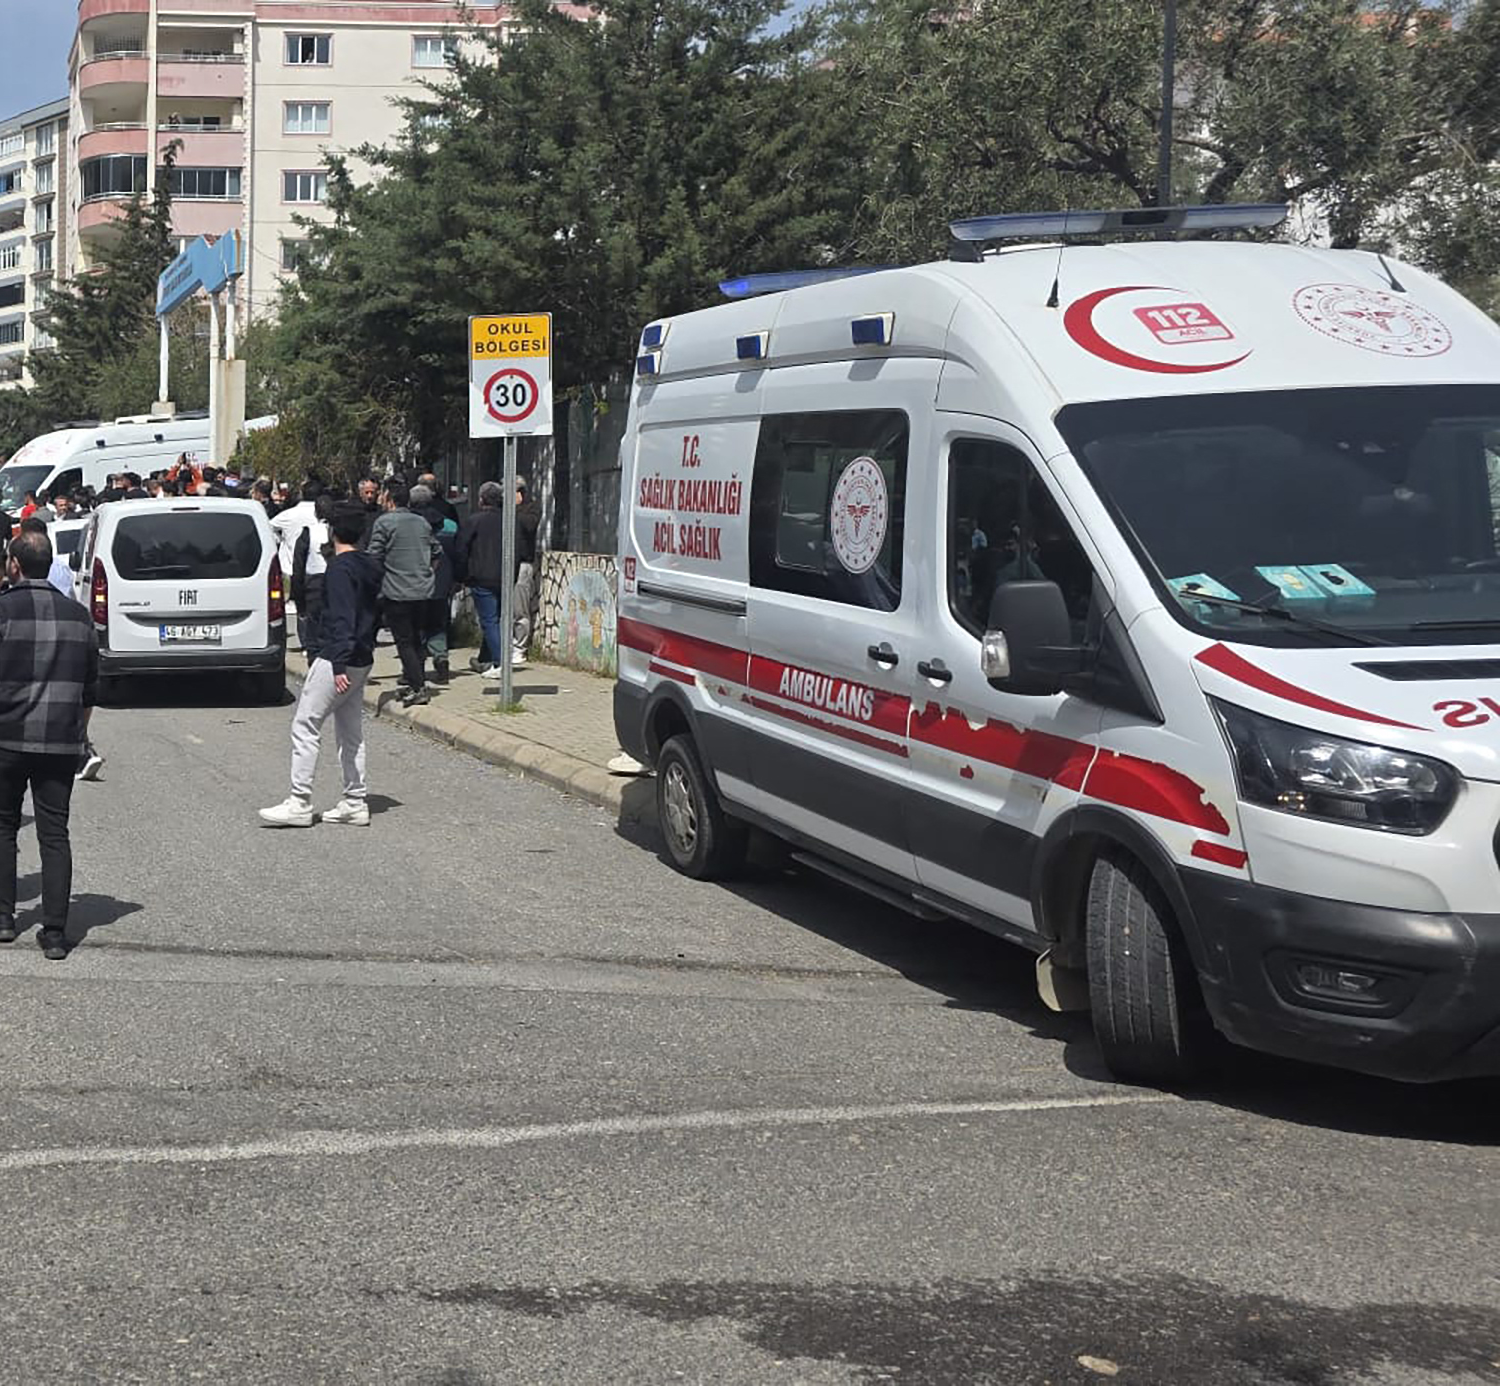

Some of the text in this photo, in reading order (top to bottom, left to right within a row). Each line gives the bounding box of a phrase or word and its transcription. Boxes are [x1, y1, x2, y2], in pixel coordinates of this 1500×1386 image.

[488, 323, 533, 335] OKUL
[1147, 308, 1211, 328] 112
[475, 336, 546, 353] BÖLGESİ
[495, 383, 526, 407] 30
[681, 435, 701, 468] T.C.
[640, 472, 742, 515] SAĞLIK BAKANLIĞI
[653, 516, 722, 561] ACİL SAĞLIK
[179, 590, 198, 605] FIAT
[779, 666, 876, 721] AMBULANS
